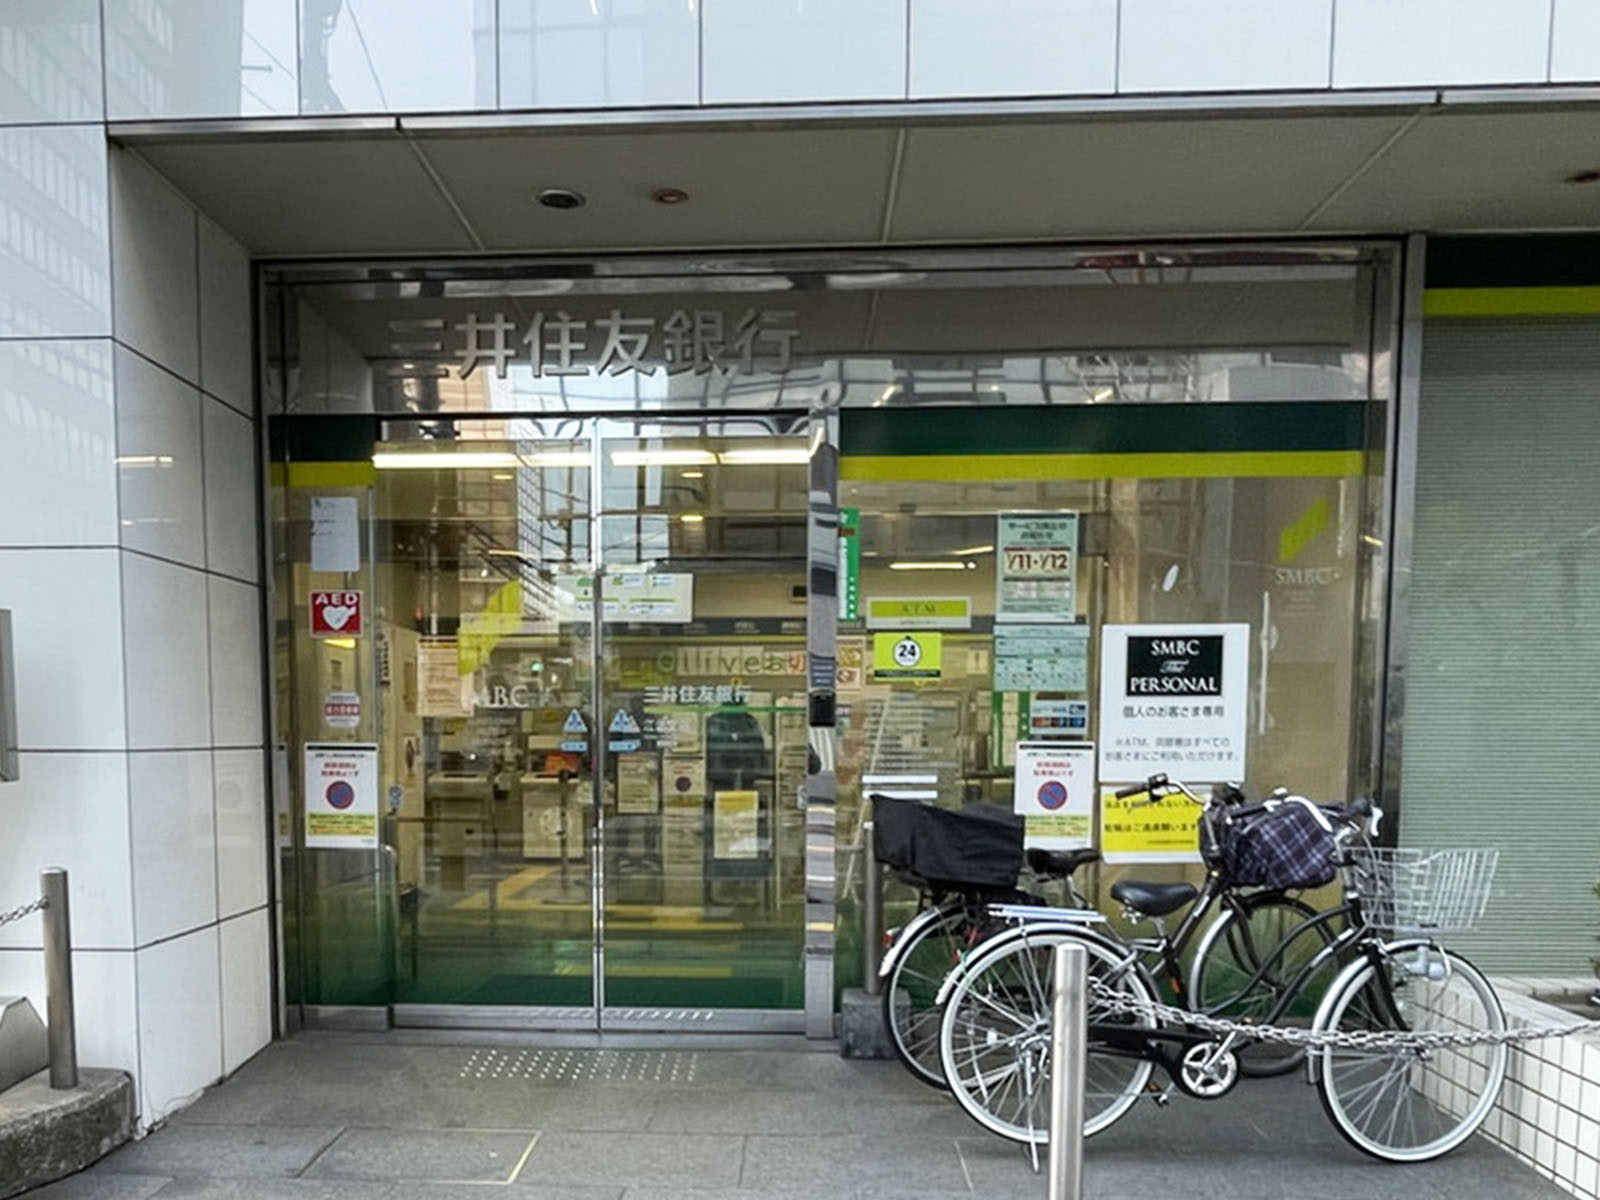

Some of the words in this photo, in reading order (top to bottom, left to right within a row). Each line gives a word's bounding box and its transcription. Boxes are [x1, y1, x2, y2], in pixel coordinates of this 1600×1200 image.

[388, 308, 799, 379] 三井住友銀行
[315, 593, 358, 605] AED
[902, 604, 936, 616] ATM
[898, 645, 916, 657] 24
[1150, 639, 1200, 656] SMBC
[1130, 677, 1219, 692] PERSONAL
[643, 685, 751, 703] 三井住友銀行
[1123, 706, 1224, 718] 個人のお客さま専用
